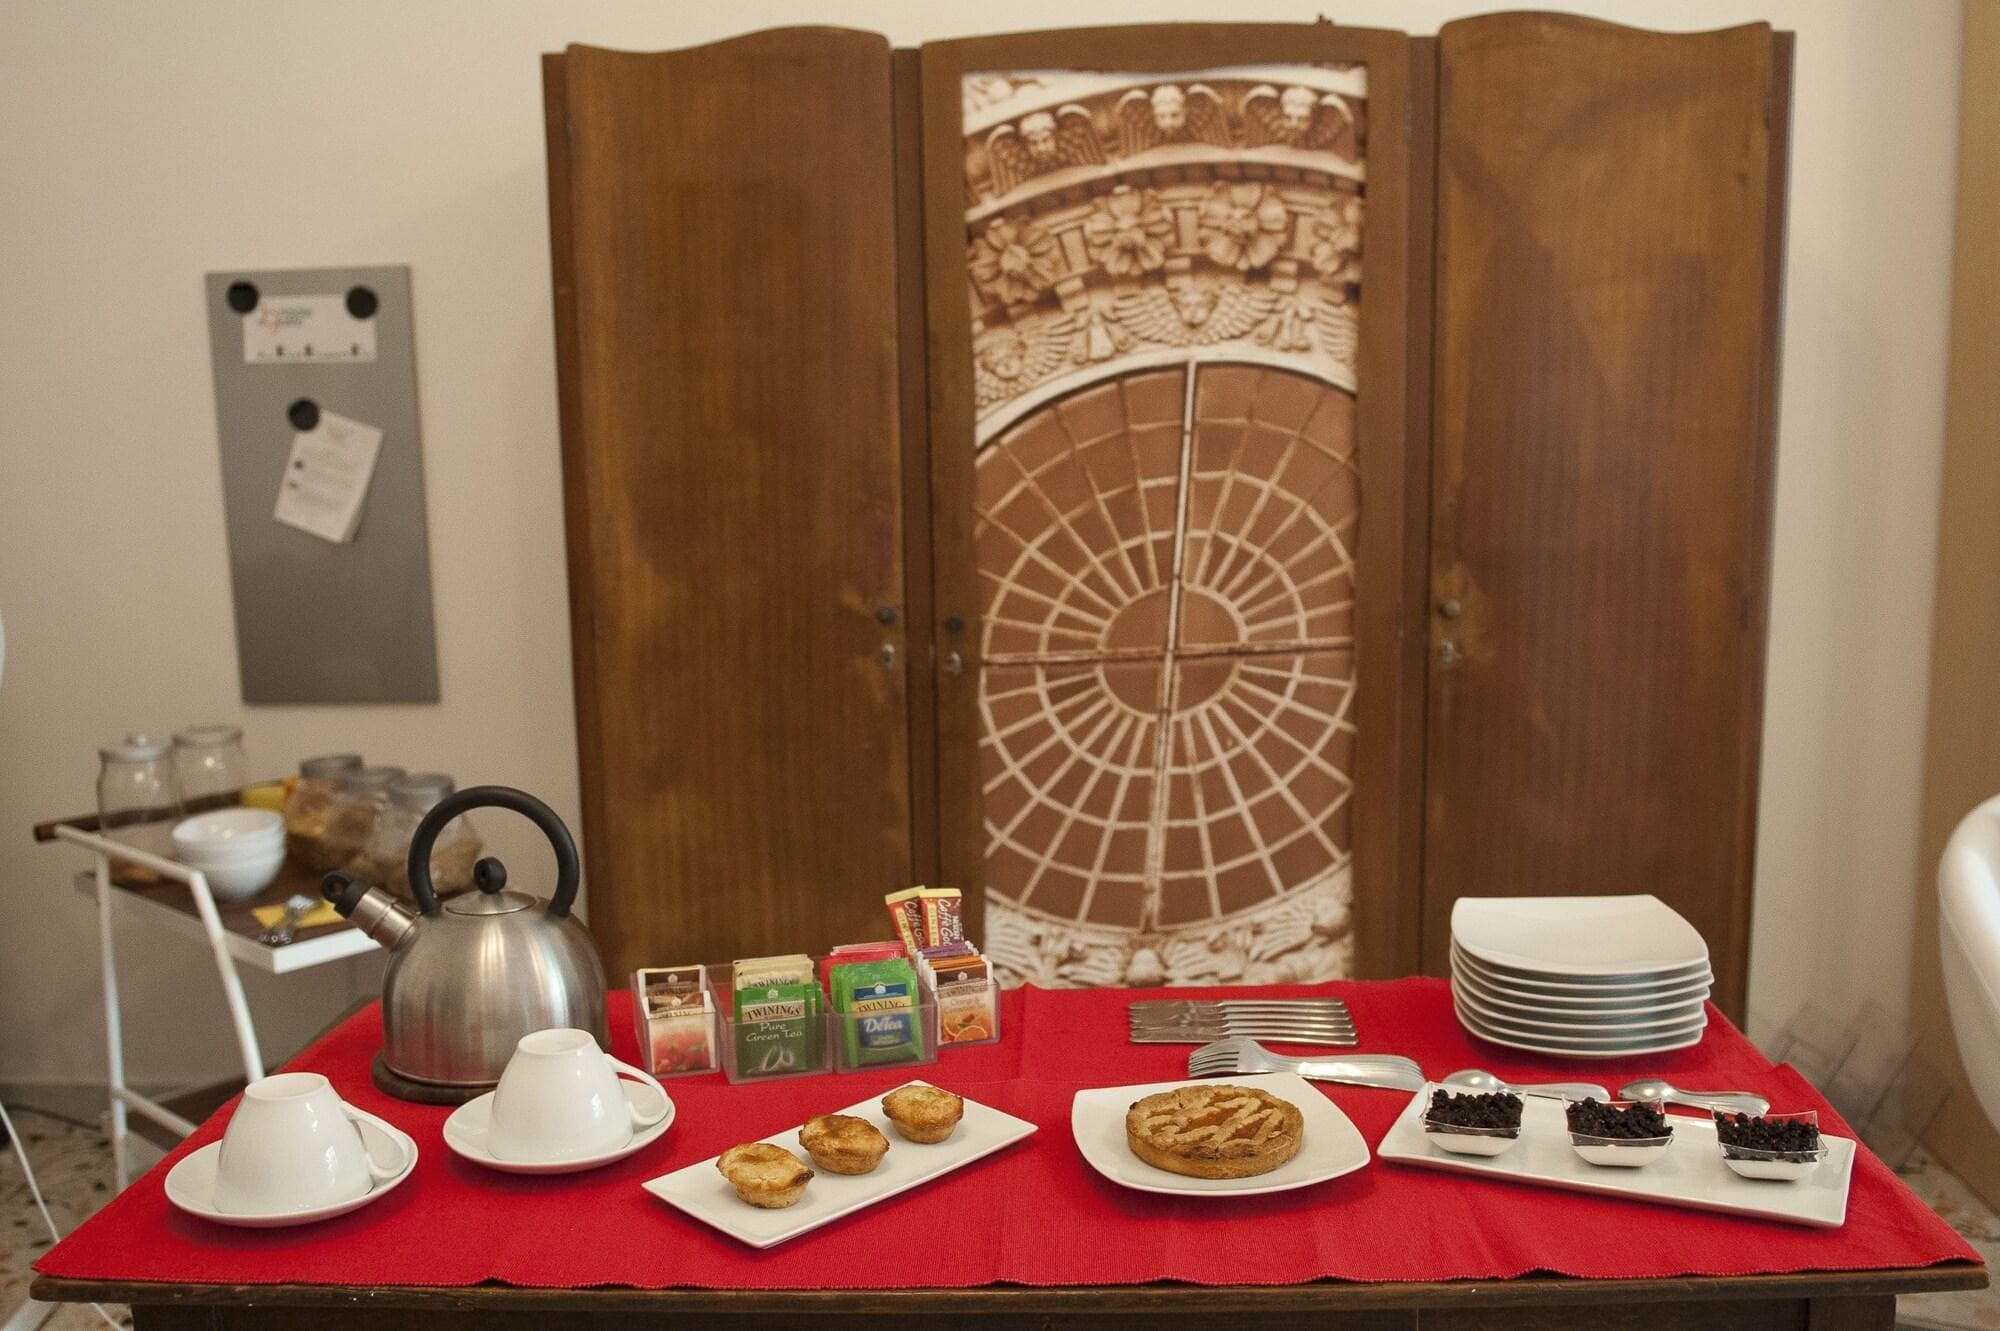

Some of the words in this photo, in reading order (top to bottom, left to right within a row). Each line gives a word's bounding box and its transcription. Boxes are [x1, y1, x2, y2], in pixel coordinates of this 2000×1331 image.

[745, 1005, 802, 1021] TWININGS
[760, 1022, 787, 1032] Pure
[746, 1033, 780, 1042] Green
[783, 1029, 803, 1038] Tea
